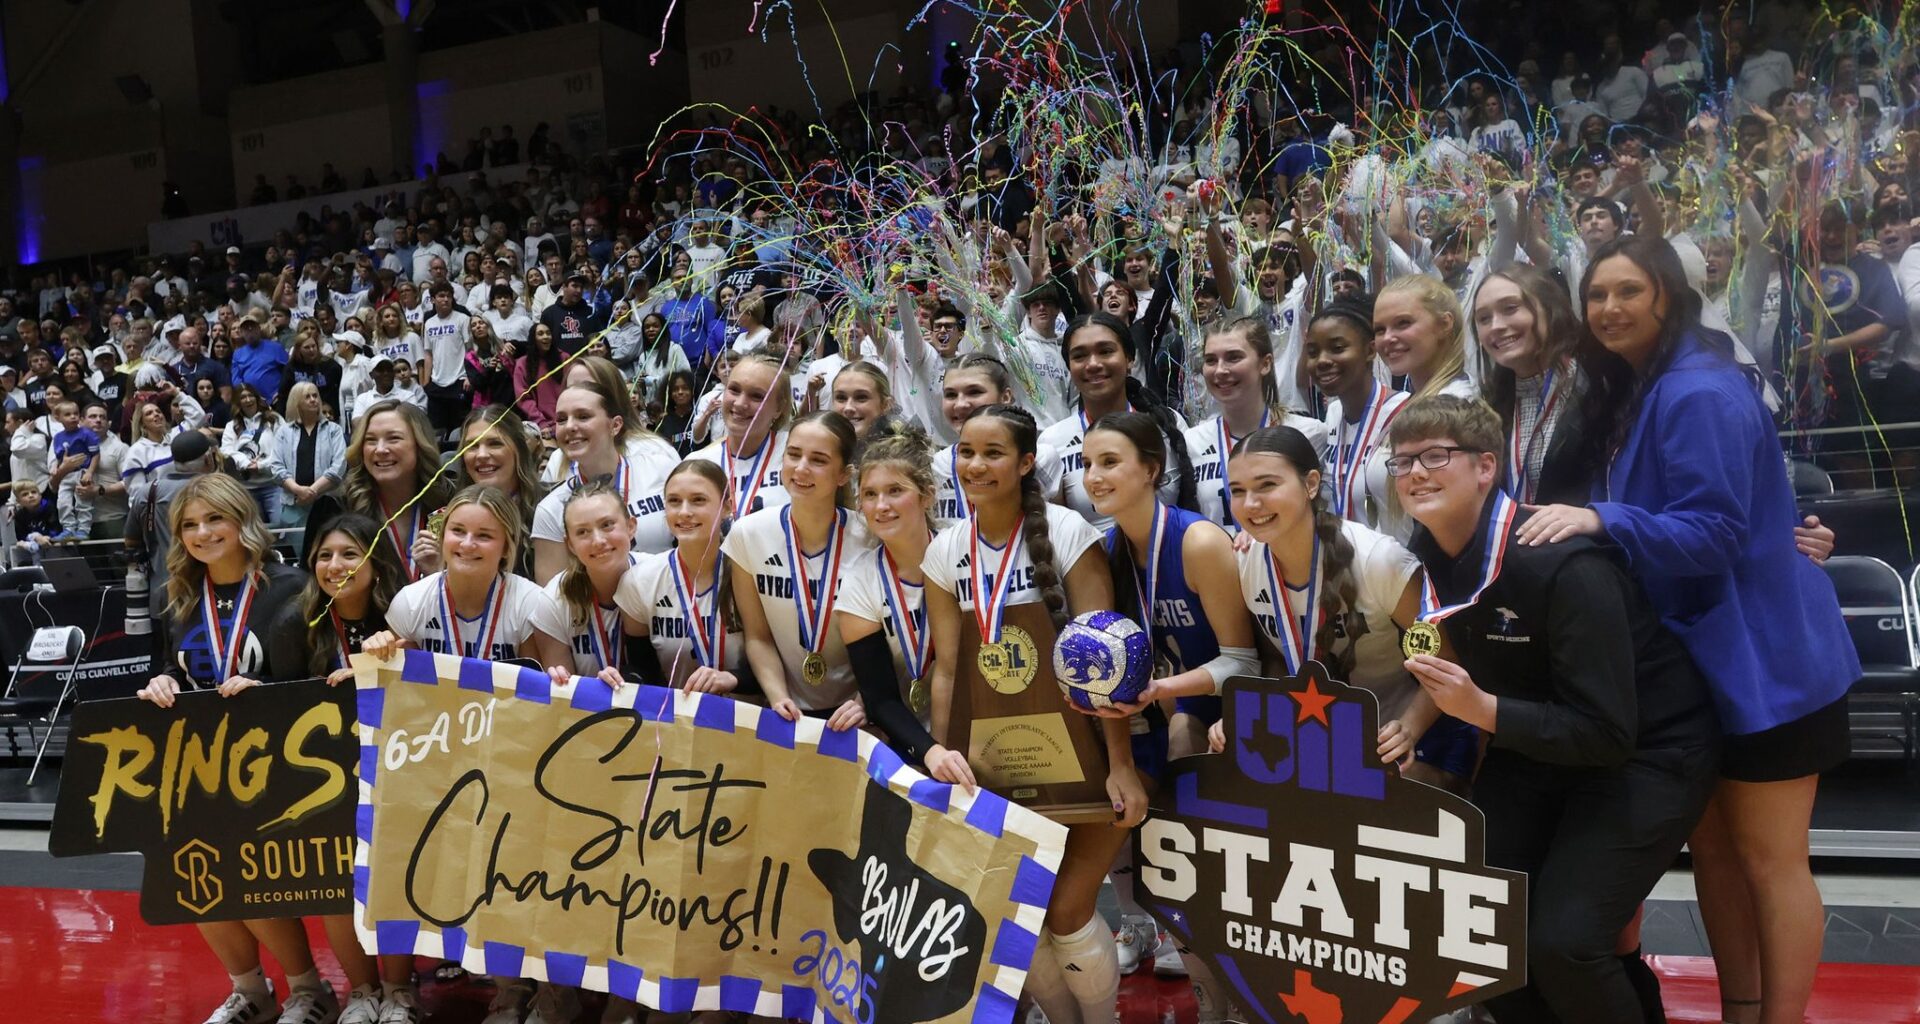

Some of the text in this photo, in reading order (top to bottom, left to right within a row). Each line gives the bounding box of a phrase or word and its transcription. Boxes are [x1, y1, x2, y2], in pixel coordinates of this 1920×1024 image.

[698, 48, 734, 70] 102
[241, 133, 265, 152] 101
[727, 272, 756, 285] STATE
[428, 324, 455, 337] STATE
[756, 573, 793, 599] BYRO
[1152, 598, 1196, 628] CATS
[88, 666, 129, 679] CULWELL
[384, 697, 498, 771] 6A D1
[1234, 689, 1386, 801] UIL
[1013, 746, 1044, 754] CHAMPION
[992, 763, 1029, 771] CONFERENCE
[534, 707, 767, 875] State
[244, 887, 347, 904] RECOGNITION
[1140, 817, 1509, 970] STATE
[1225, 920, 1407, 987] CHAMPIONS
[792, 930, 881, 1024] 2025
